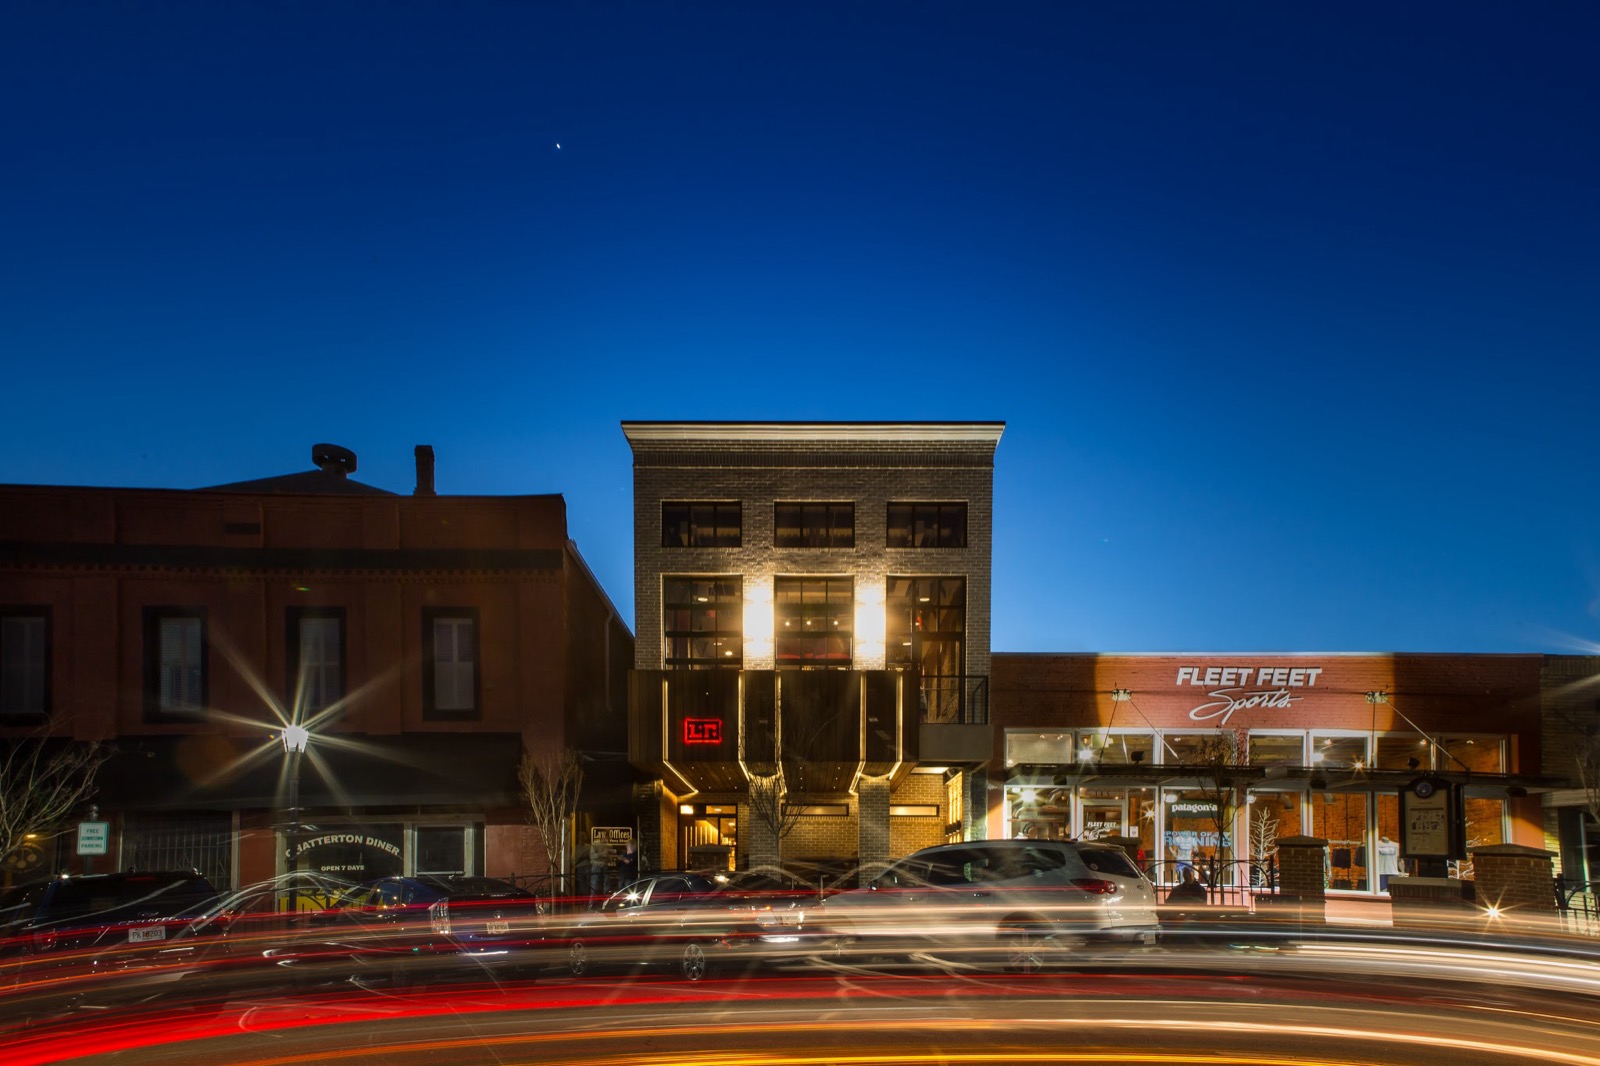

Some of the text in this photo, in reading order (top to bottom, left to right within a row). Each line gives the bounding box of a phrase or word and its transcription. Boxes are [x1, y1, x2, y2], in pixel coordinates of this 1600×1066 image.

[1176, 667, 1322, 686] FLEET FEET
[1171, 803, 1218, 813] patagonia
[593, 829, 630, 839] Law Offices
[285, 834, 401, 858] CHATTERTON DINER
